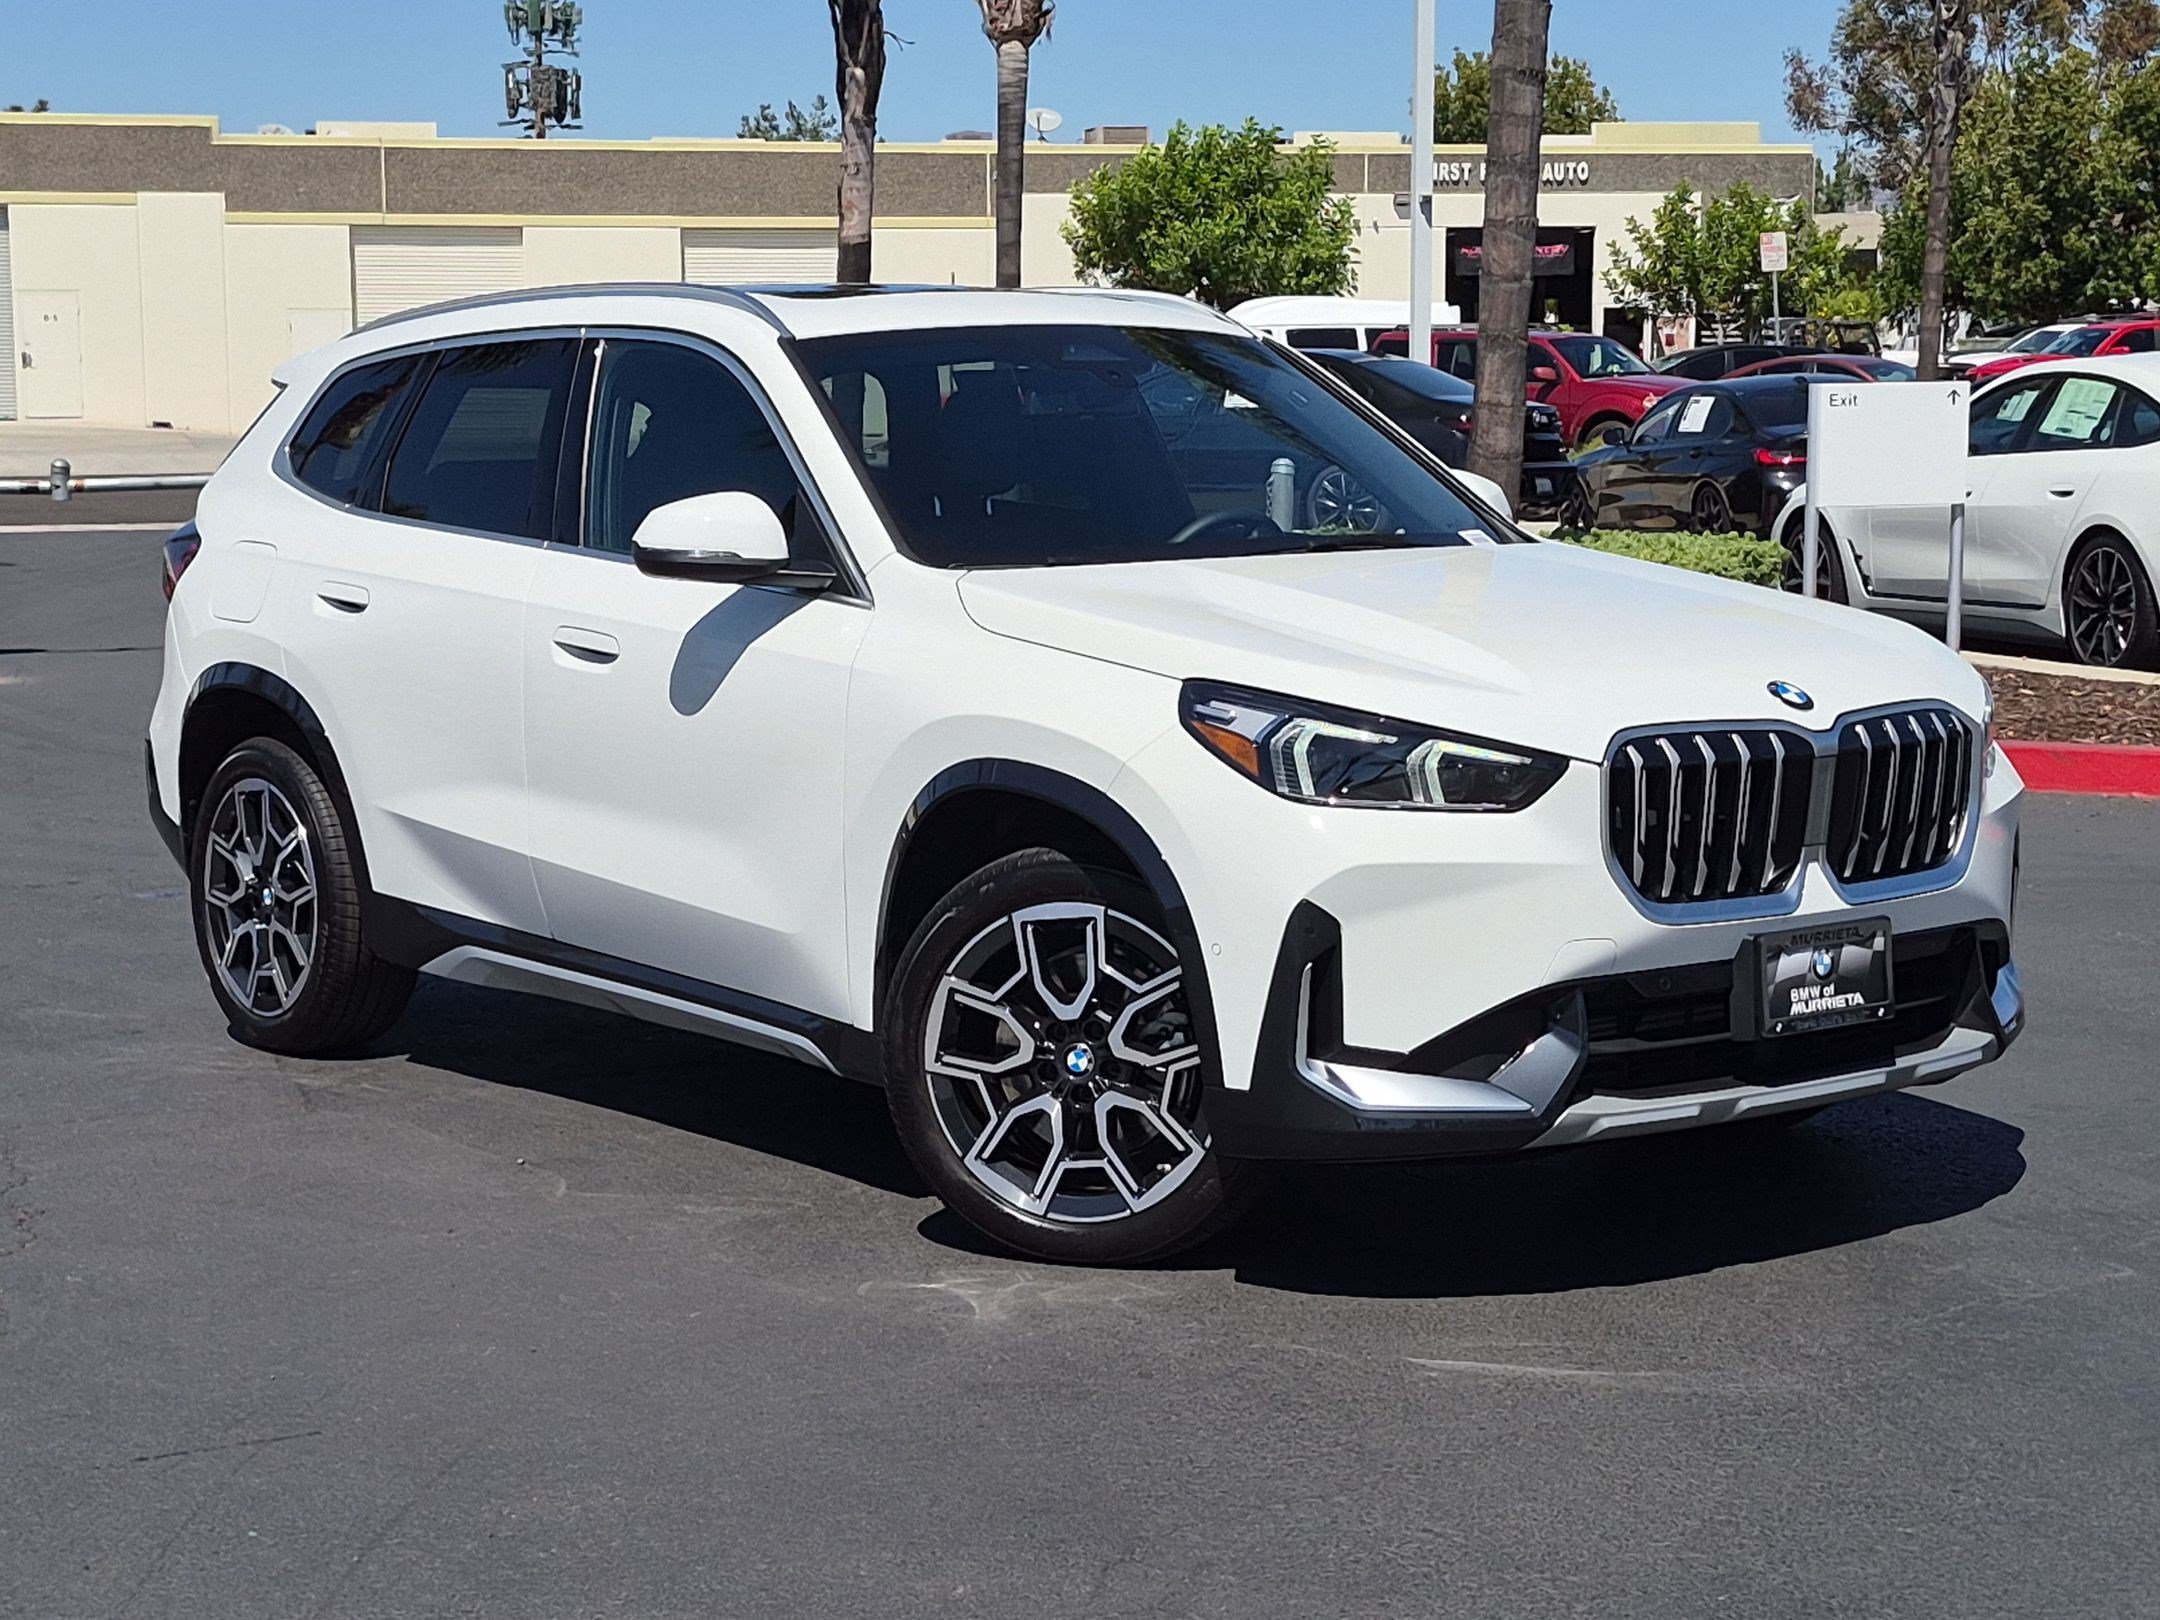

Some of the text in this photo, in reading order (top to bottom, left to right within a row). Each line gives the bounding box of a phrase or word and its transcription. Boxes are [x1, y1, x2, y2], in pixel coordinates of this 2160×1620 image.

[1433, 162, 1472, 181] IRST
[1541, 161, 1590, 181] AUTO
[1829, 393, 1858, 407] Exit
[1791, 926, 1863, 945] MURRIETA
[1790, 982, 1835, 1002] BMW of
[1790, 992, 1864, 1016] MURRIETA
